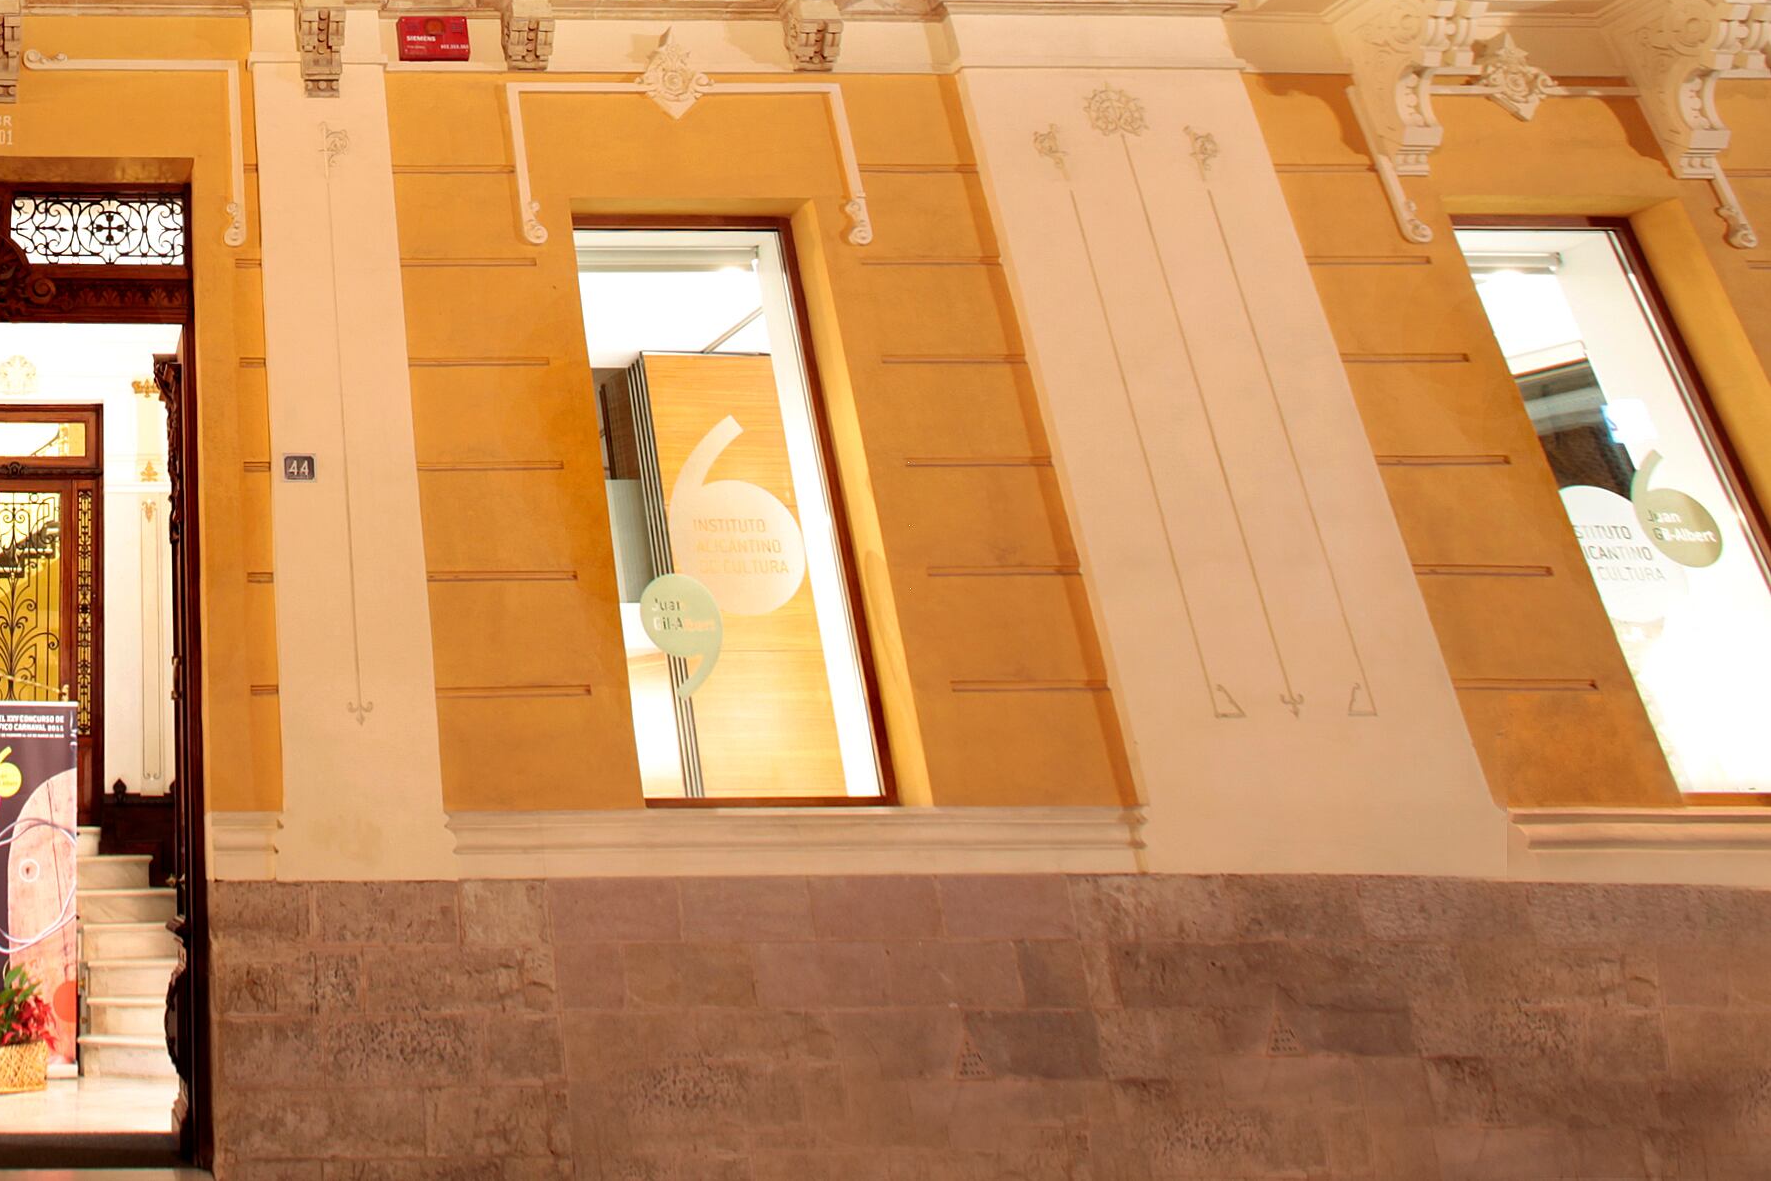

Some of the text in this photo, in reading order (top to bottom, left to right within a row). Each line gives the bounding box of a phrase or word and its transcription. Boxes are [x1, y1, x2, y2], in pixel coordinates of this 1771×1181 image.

[288, 459, 309, 476] 44
[1647, 508, 1682, 524] Juan
[692, 518, 766, 533] INSTITUTO
[696, 538, 782, 554] ALICANTINO
[723, 559, 789, 574] CULTURA
[1597, 565, 1666, 581] CULTURA
[20, 714, 54, 724] CONCURSO
[55, 715, 65, 724] DE
[14, 723, 47, 732] CARNAVAL
